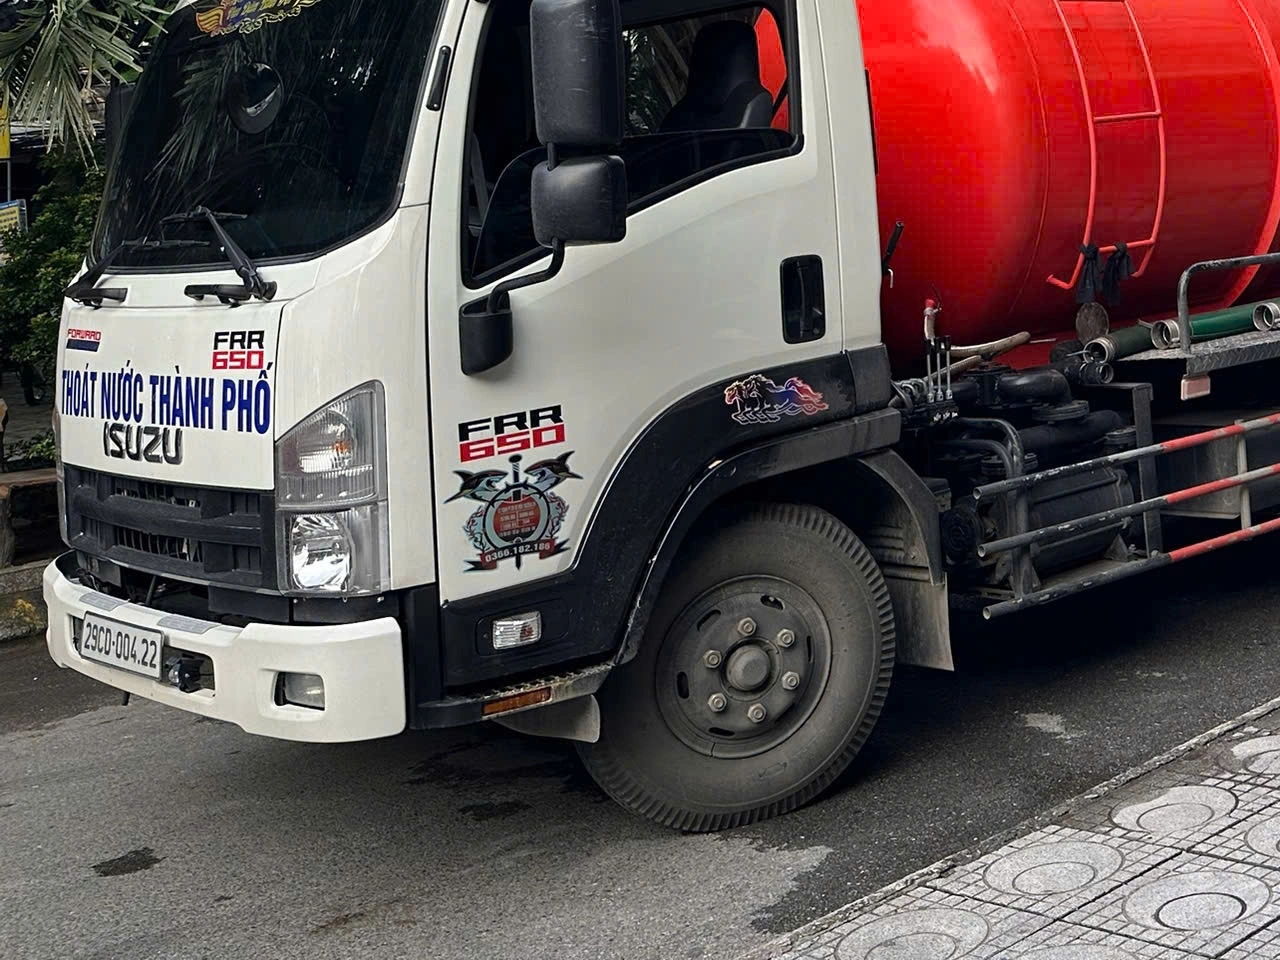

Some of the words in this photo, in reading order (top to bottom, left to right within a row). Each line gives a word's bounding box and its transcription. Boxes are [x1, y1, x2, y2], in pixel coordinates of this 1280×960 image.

[67, 328, 102, 341] FORWARD
[213, 330, 265, 350] FRR
[212, 350, 264, 370] 650
[62, 363, 97, 418] THOÁT
[101, 360, 144, 424] NƯỚC
[149, 365, 215, 430] THÀNH
[221, 362, 274, 435] PHỐ
[458, 404, 564, 442] FRR
[103, 422, 184, 466] ISUZU
[459, 423, 566, 463] 650
[84, 622, 157, 669] 29CD-004.22
